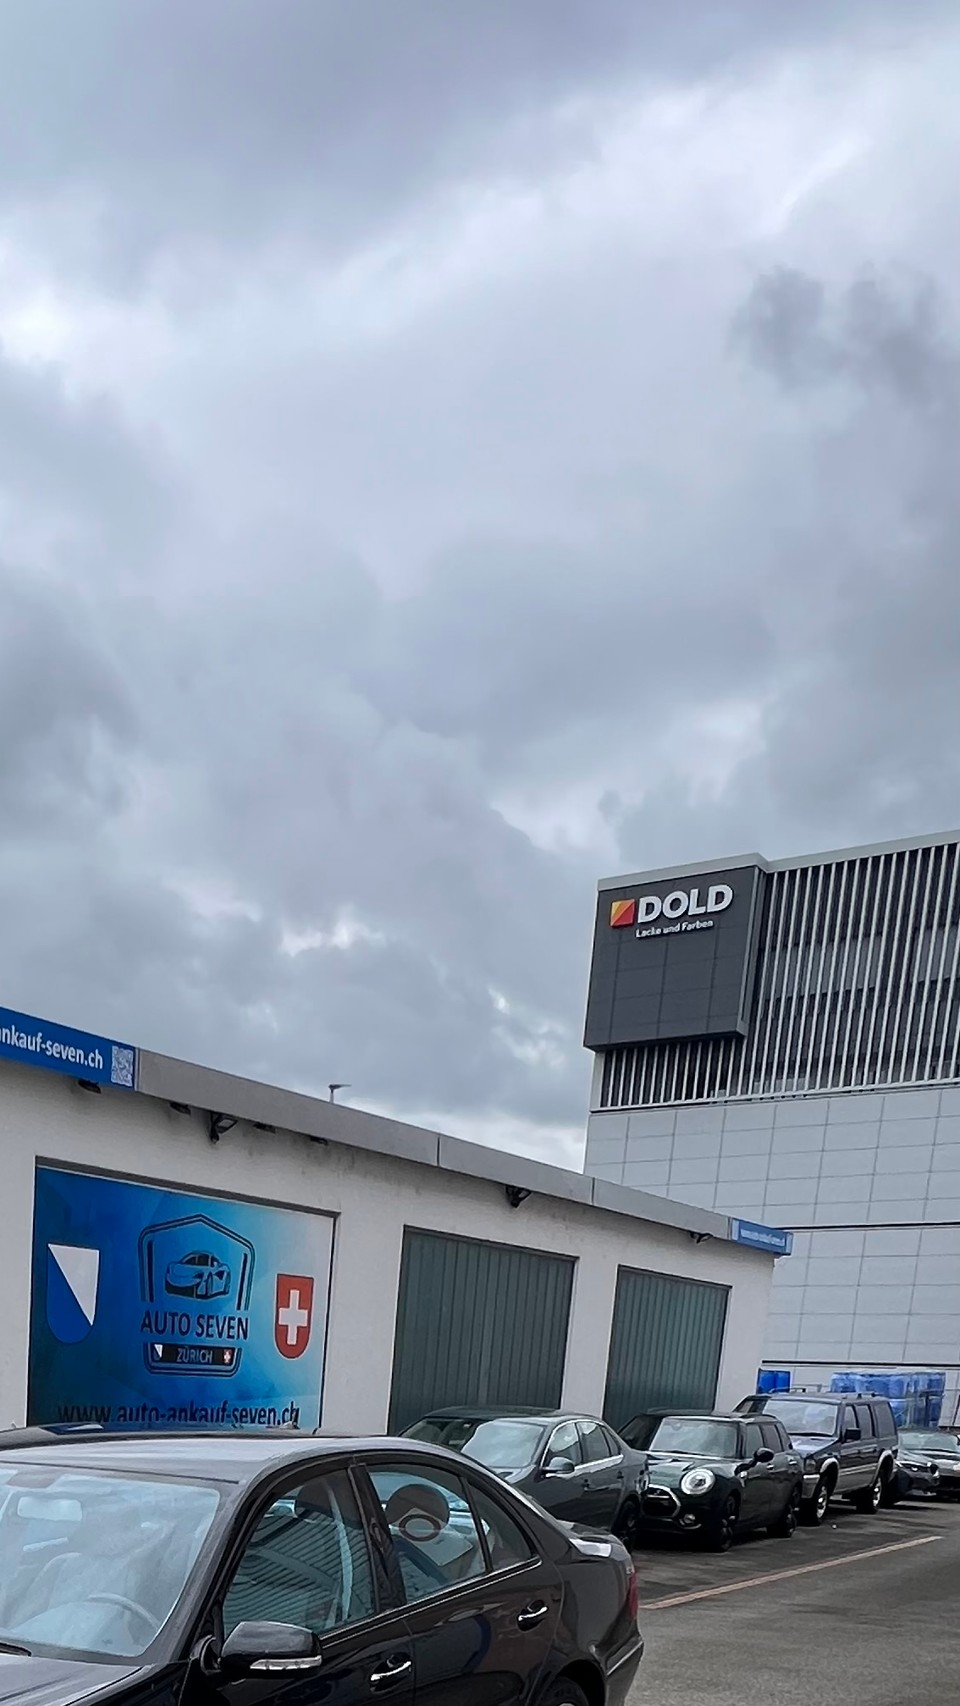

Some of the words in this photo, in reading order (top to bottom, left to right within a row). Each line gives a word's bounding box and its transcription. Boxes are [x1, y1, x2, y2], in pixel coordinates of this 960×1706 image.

[637, 884, 733, 924] DOLD
[635, 926, 662, 938] Lacke
[663, 923, 681, 934] und
[682, 920, 713, 931] Farben
[140, 1310, 192, 1336] AUTO
[195, 1313, 249, 1341] SEVEN
[176, 1346, 213, 1364] ZÜRICH
[58, 1401, 300, 1428] wwwauto-ankauf-seven.ch
